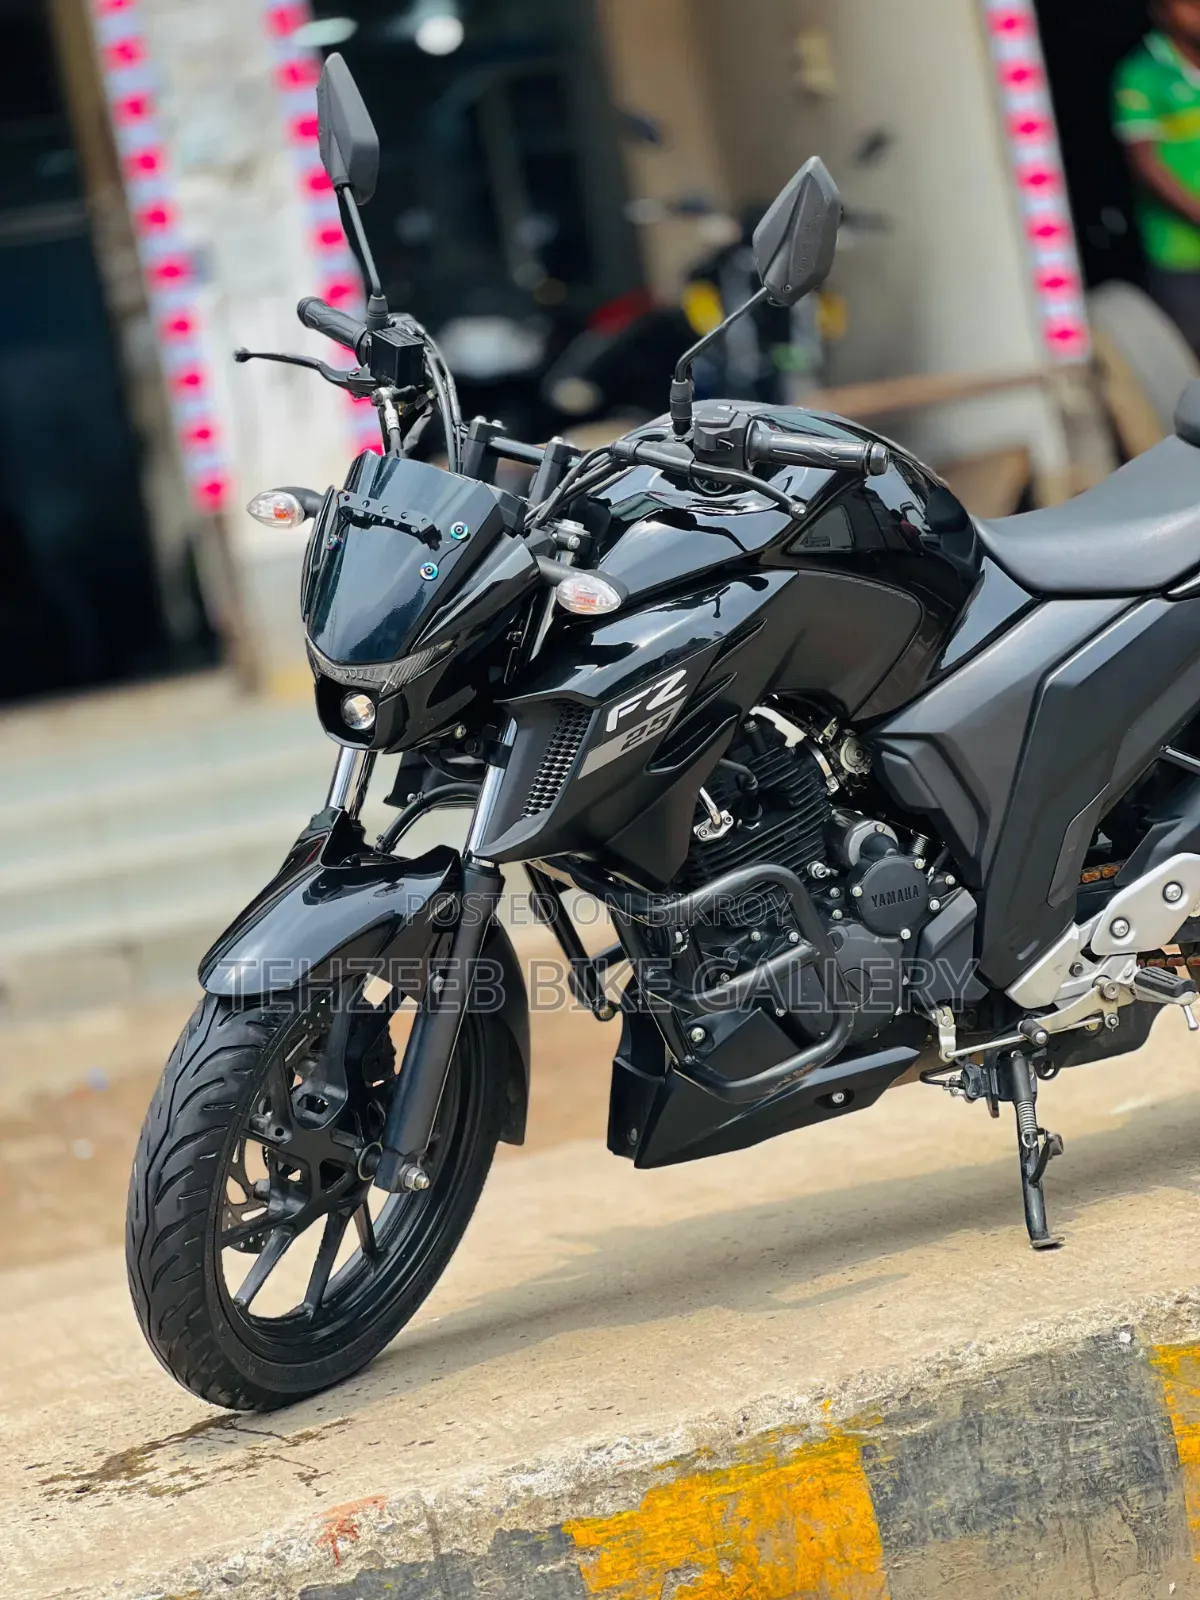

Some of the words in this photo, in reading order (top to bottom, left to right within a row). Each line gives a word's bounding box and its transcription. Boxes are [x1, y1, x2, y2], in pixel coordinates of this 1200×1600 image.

[605, 669, 688, 732] FZ
[620, 708, 675, 752] 25
[871, 884, 920, 908] YAMAHA
